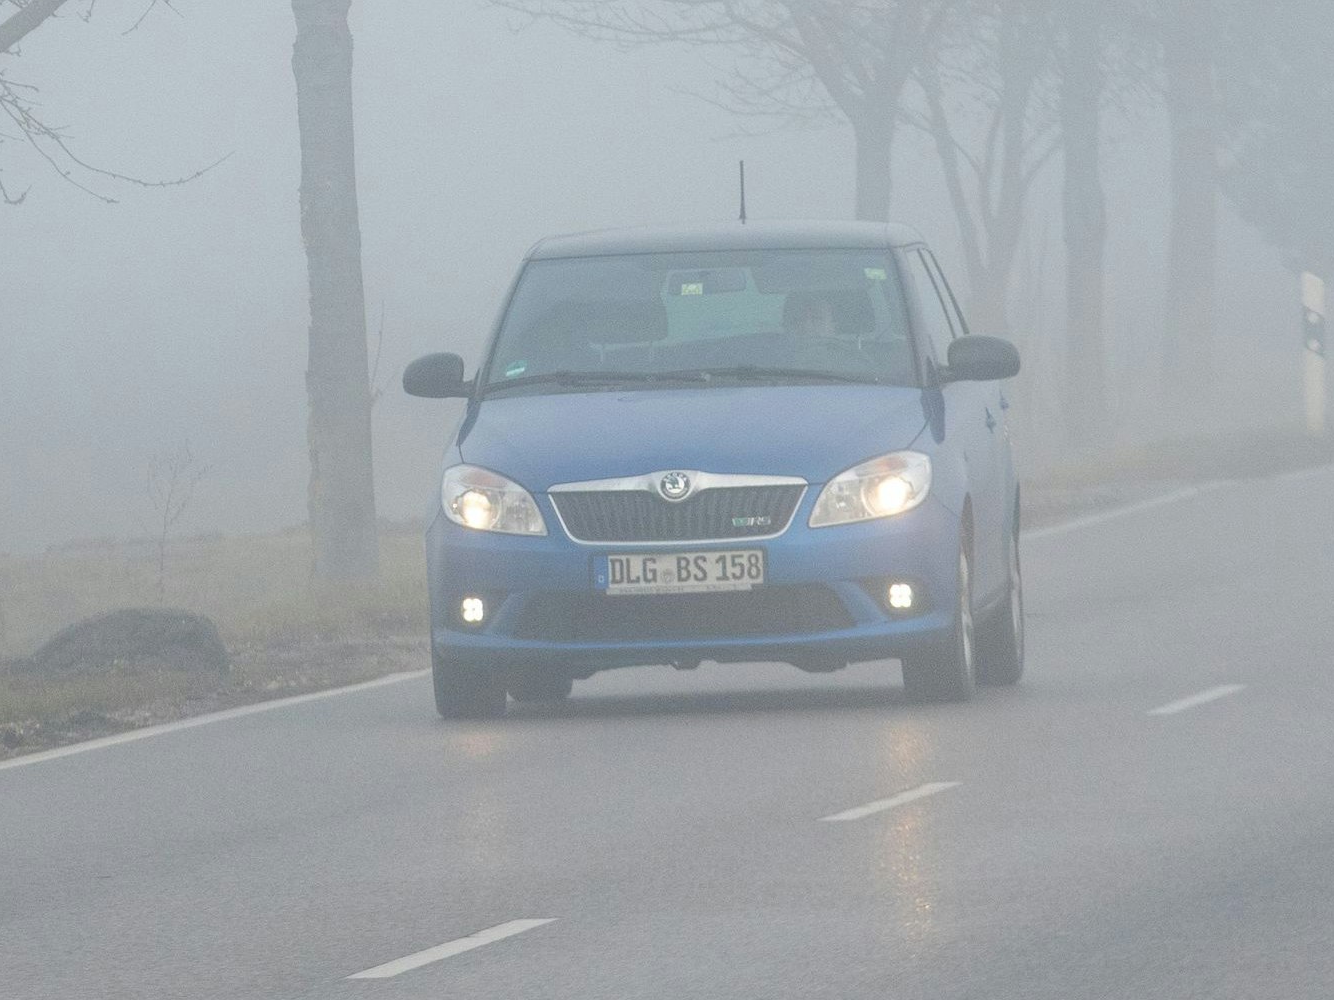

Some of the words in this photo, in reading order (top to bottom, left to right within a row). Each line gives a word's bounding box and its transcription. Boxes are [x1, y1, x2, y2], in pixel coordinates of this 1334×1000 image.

[610, 557, 657, 584] DLG
[677, 556, 708, 583] BS
[715, 553, 761, 581] 158
